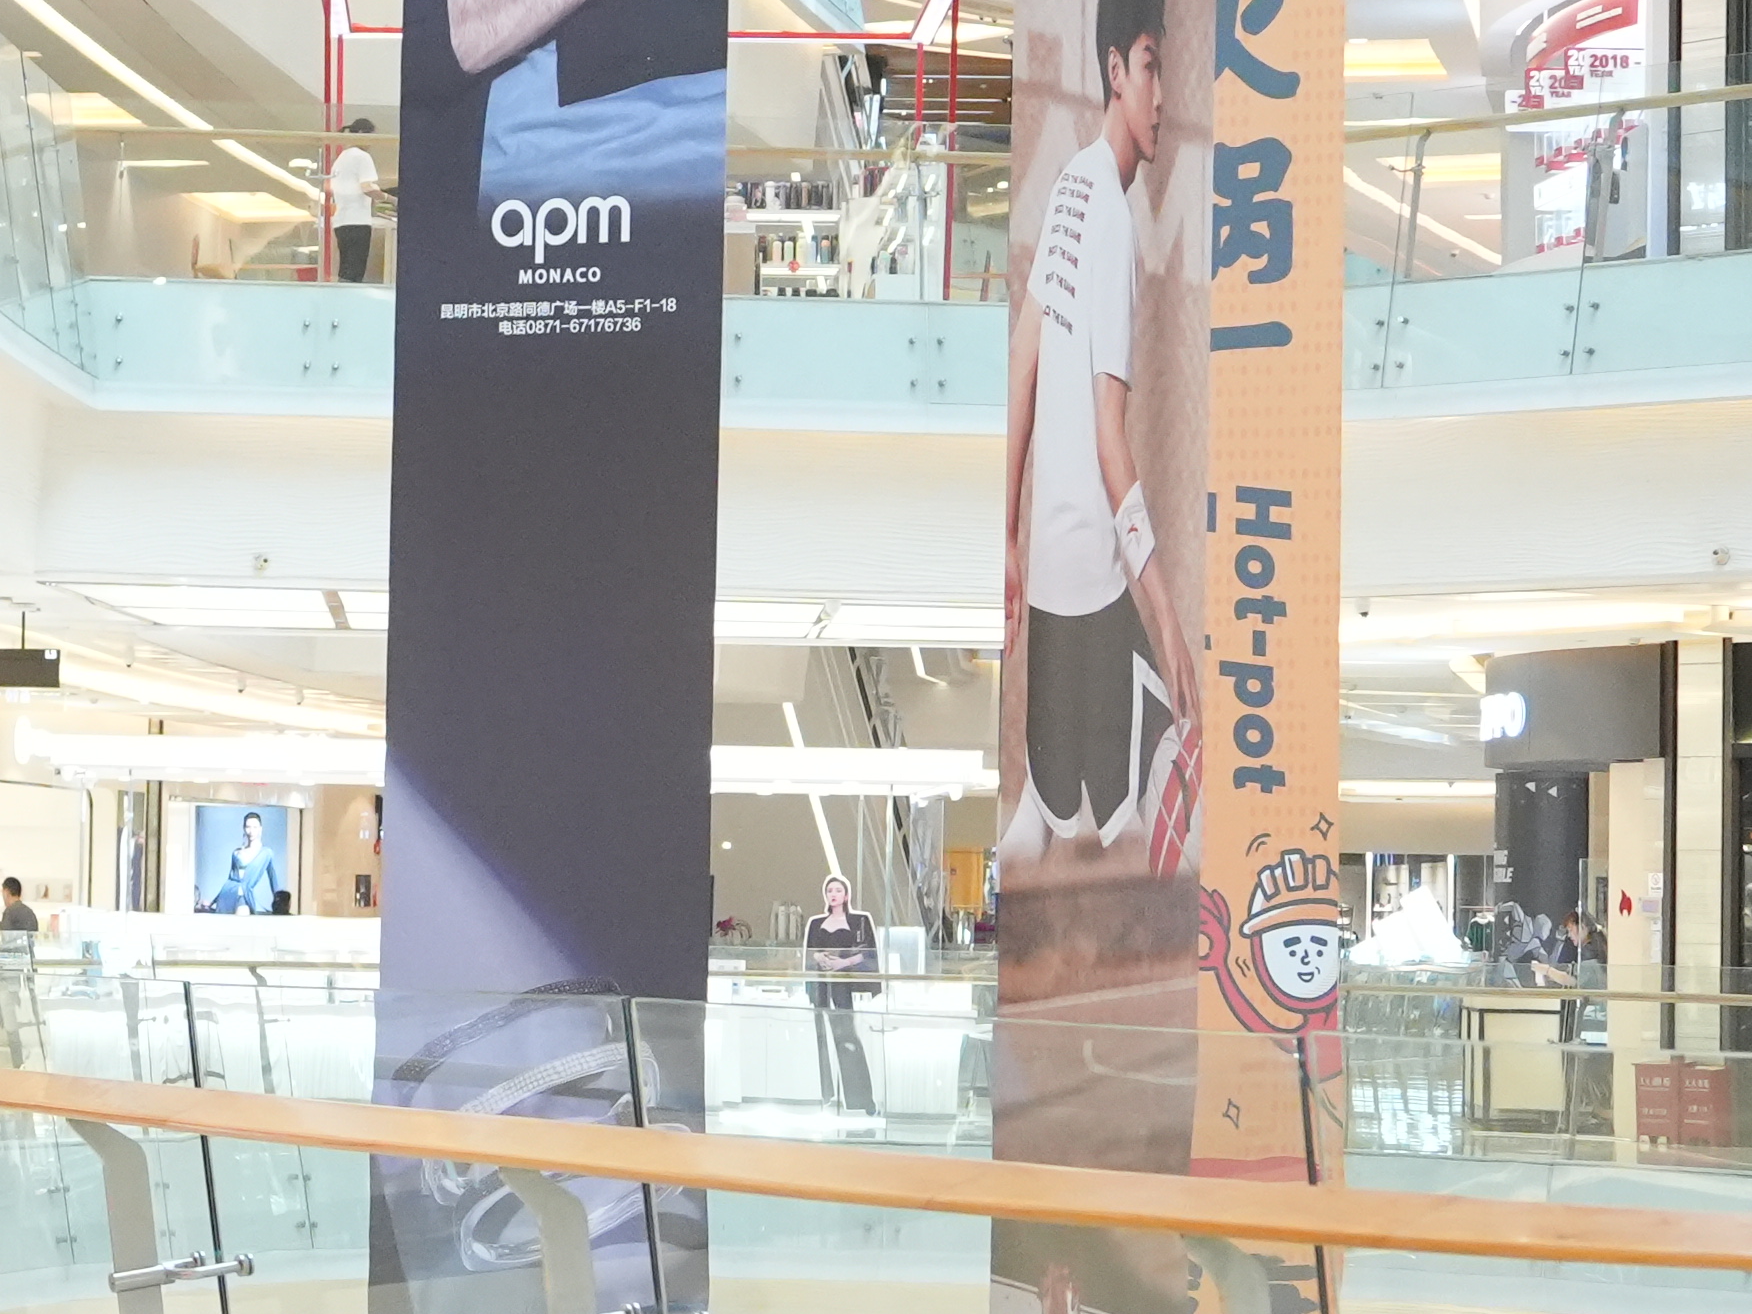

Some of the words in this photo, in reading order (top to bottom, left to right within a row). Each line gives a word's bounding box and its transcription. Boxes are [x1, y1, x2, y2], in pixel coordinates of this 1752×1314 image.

[491, 195, 631, 264] apm
[518, 267, 601, 285] MONACO
[498, 317, 642, 336] 电话0871-67176736
